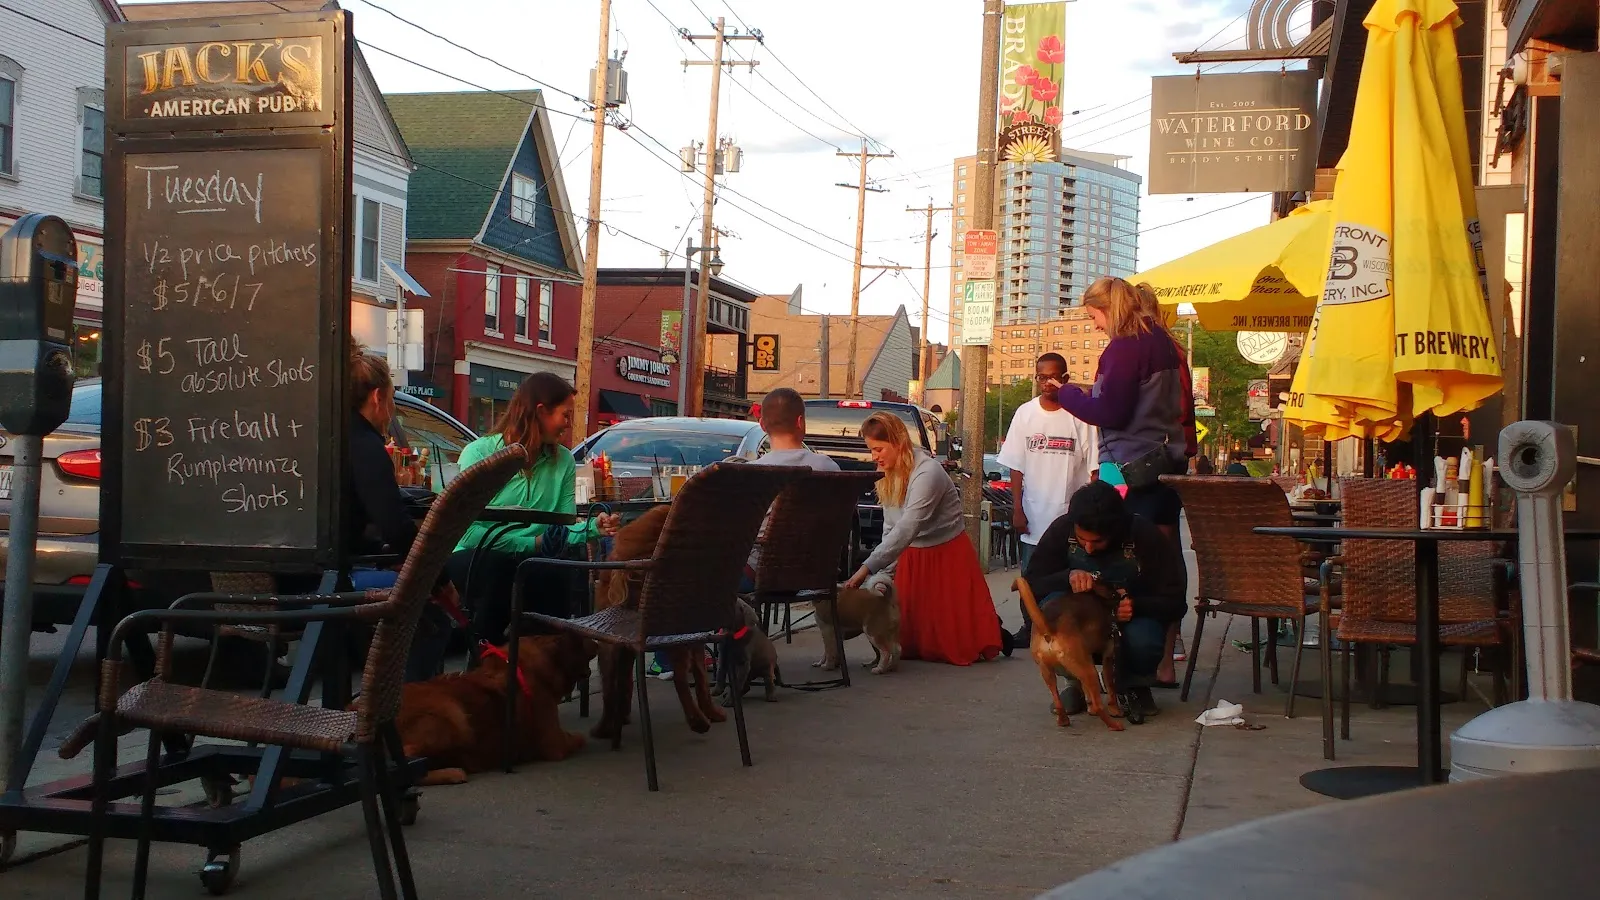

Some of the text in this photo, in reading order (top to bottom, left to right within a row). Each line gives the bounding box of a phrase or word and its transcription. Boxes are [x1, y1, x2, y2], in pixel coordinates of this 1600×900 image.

[137, 38, 313, 95] JACK'S
[1001, 16, 1026, 113] BRADY
[150, 96, 296, 118] AMERICAN PUB
[1232, 100, 1256, 108] 2005
[1008, 125, 1053, 140] STREET
[1156, 113, 1311, 134] WATERFORD
[1184, 136, 1283, 148] WINE CO.
[1169, 154, 1297, 164] BRADY STREET
[135, 165, 264, 224] Tuesday
[144, 238, 317, 281] 1/2 price pitchers
[966, 283, 973, 301] 2
[1351, 282, 1383, 298] INC.
[136, 333, 249, 375] $5 Tall
[1414, 330, 1495, 365] BREWERY,
[627, 355, 650, 371] JIMMY
[650, 360, 670, 376] JOHN'S
[133, 409, 304, 452] $3 Fireball +
